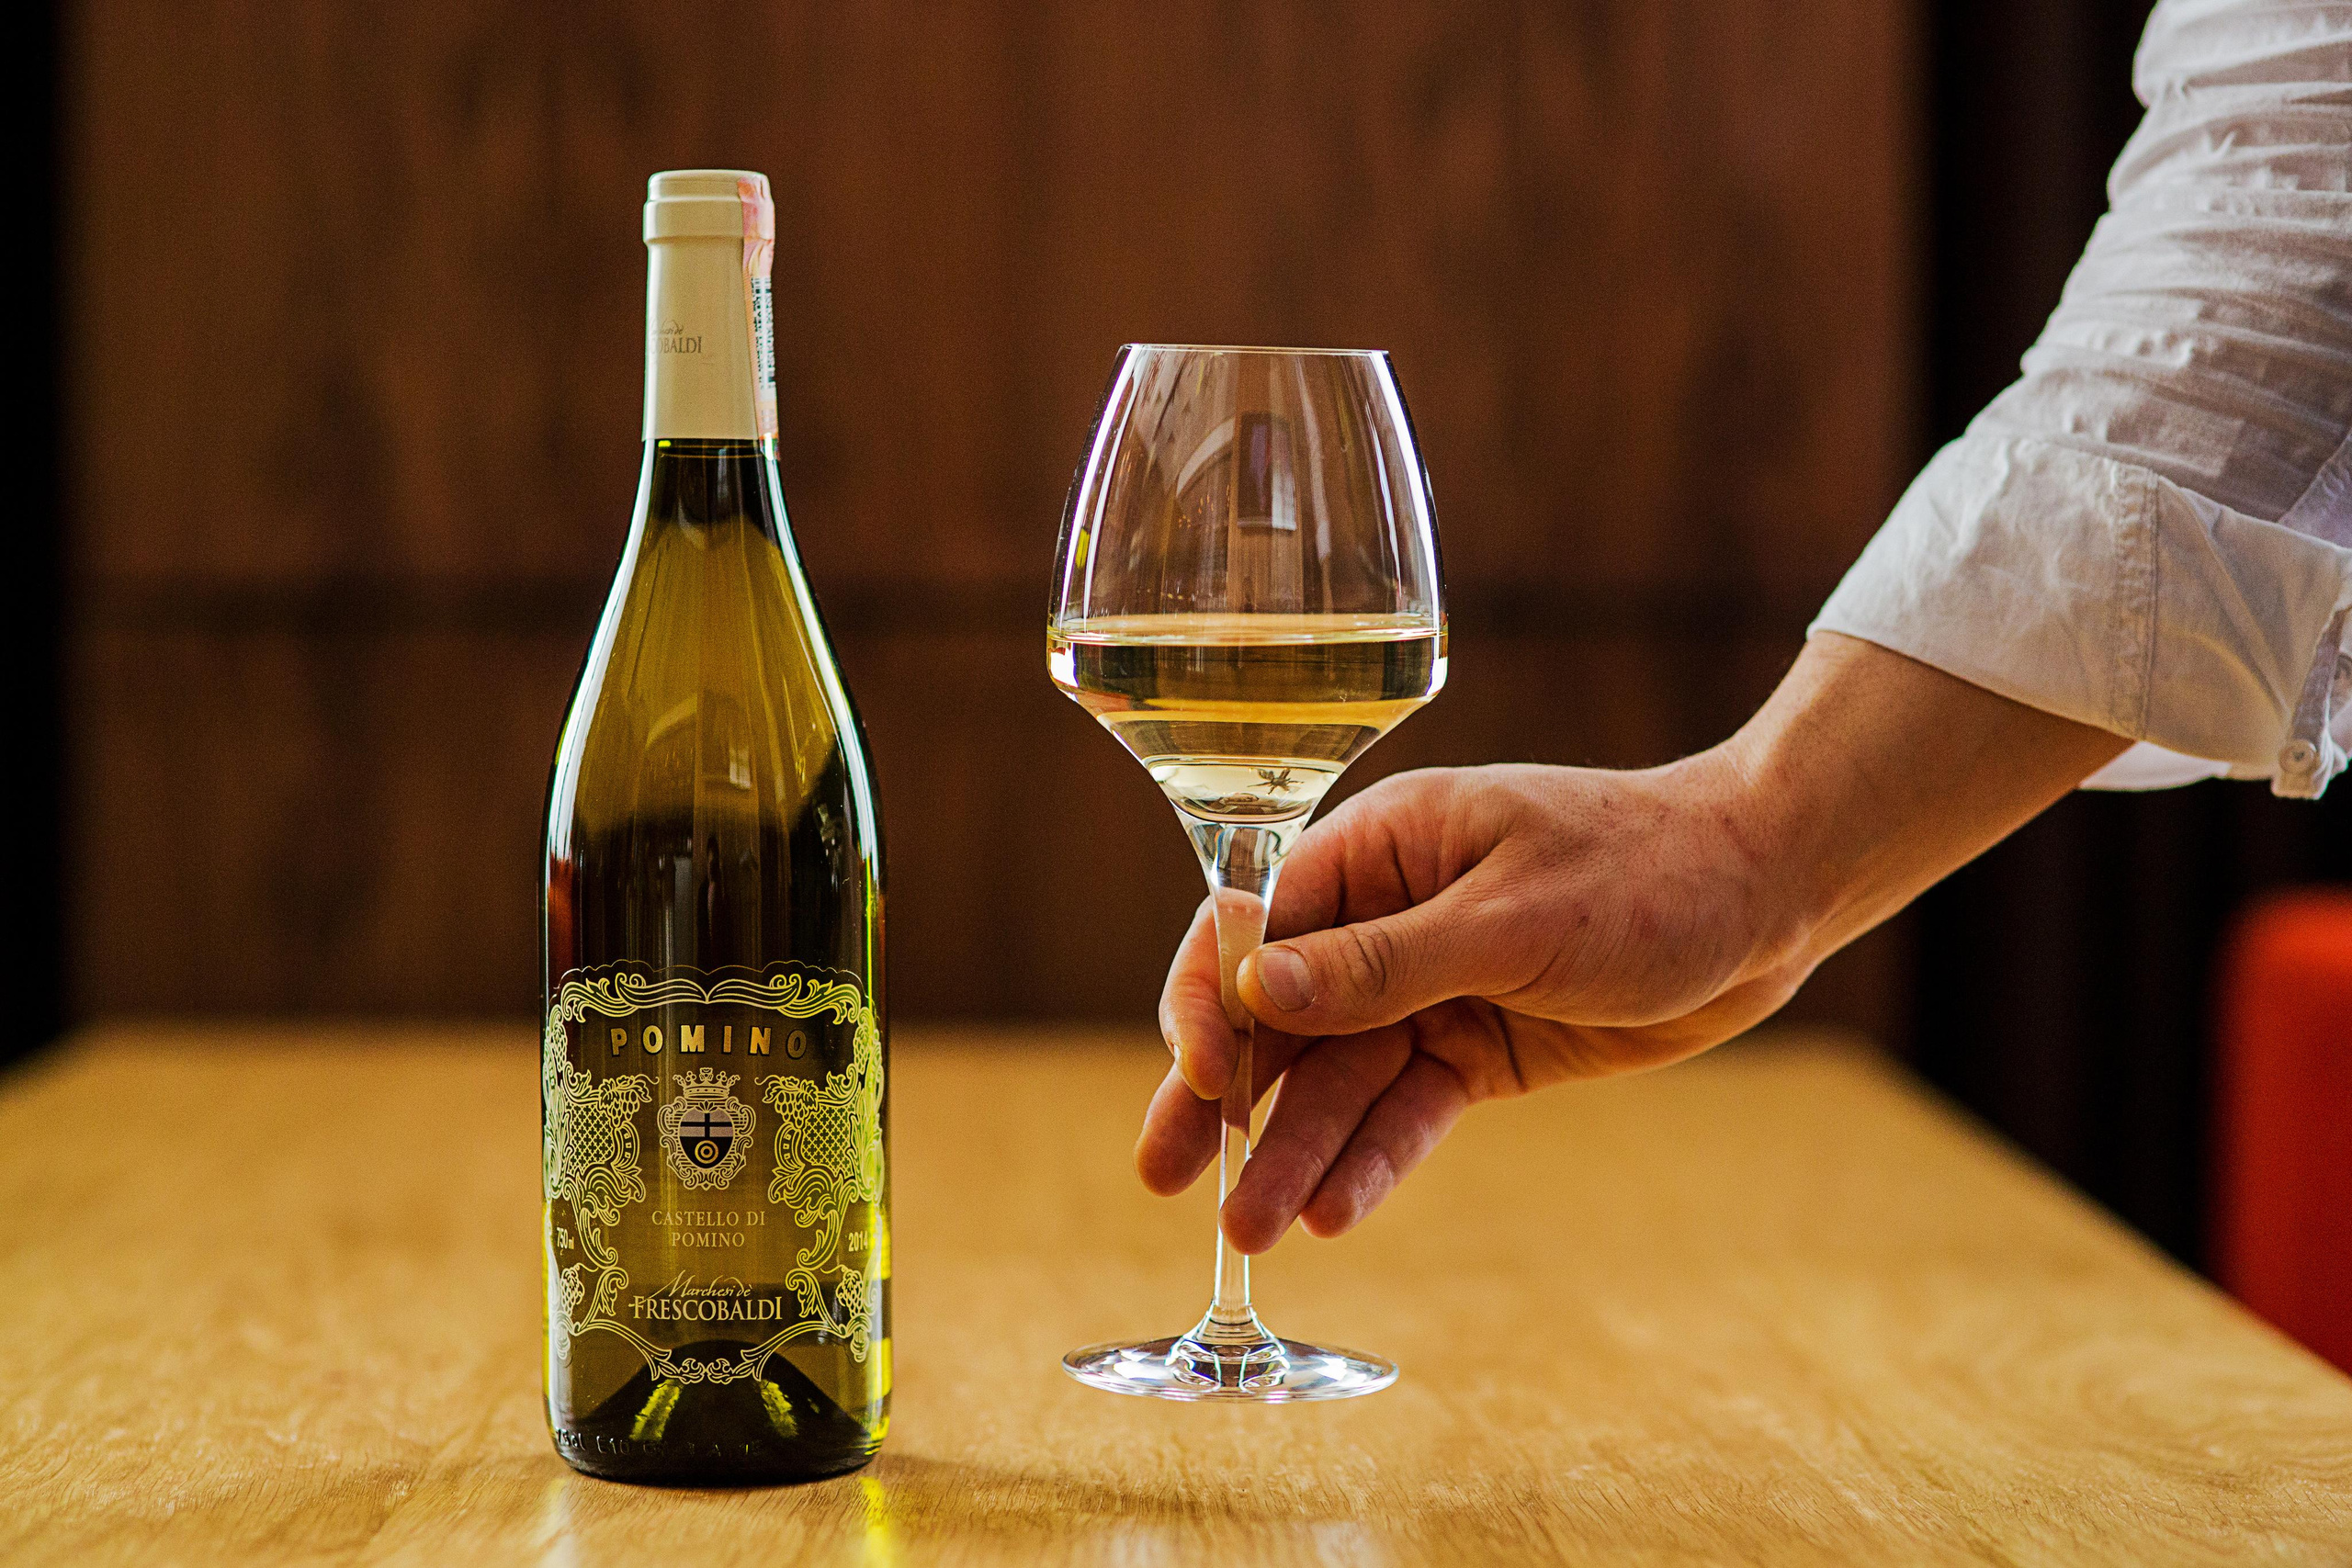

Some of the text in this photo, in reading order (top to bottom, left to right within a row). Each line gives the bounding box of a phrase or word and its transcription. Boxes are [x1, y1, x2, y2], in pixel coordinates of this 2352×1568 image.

[610, 1024, 808, 1058] POMINO
[651, 1210, 765, 1226] CASTELLO DI
[671, 1232, 745, 1247] POMINO
[848, 1230, 868, 1252] 2014
[647, 1269, 736, 1298] Marchesi
[630, 1295, 783, 1321] FRESCOBALDI
